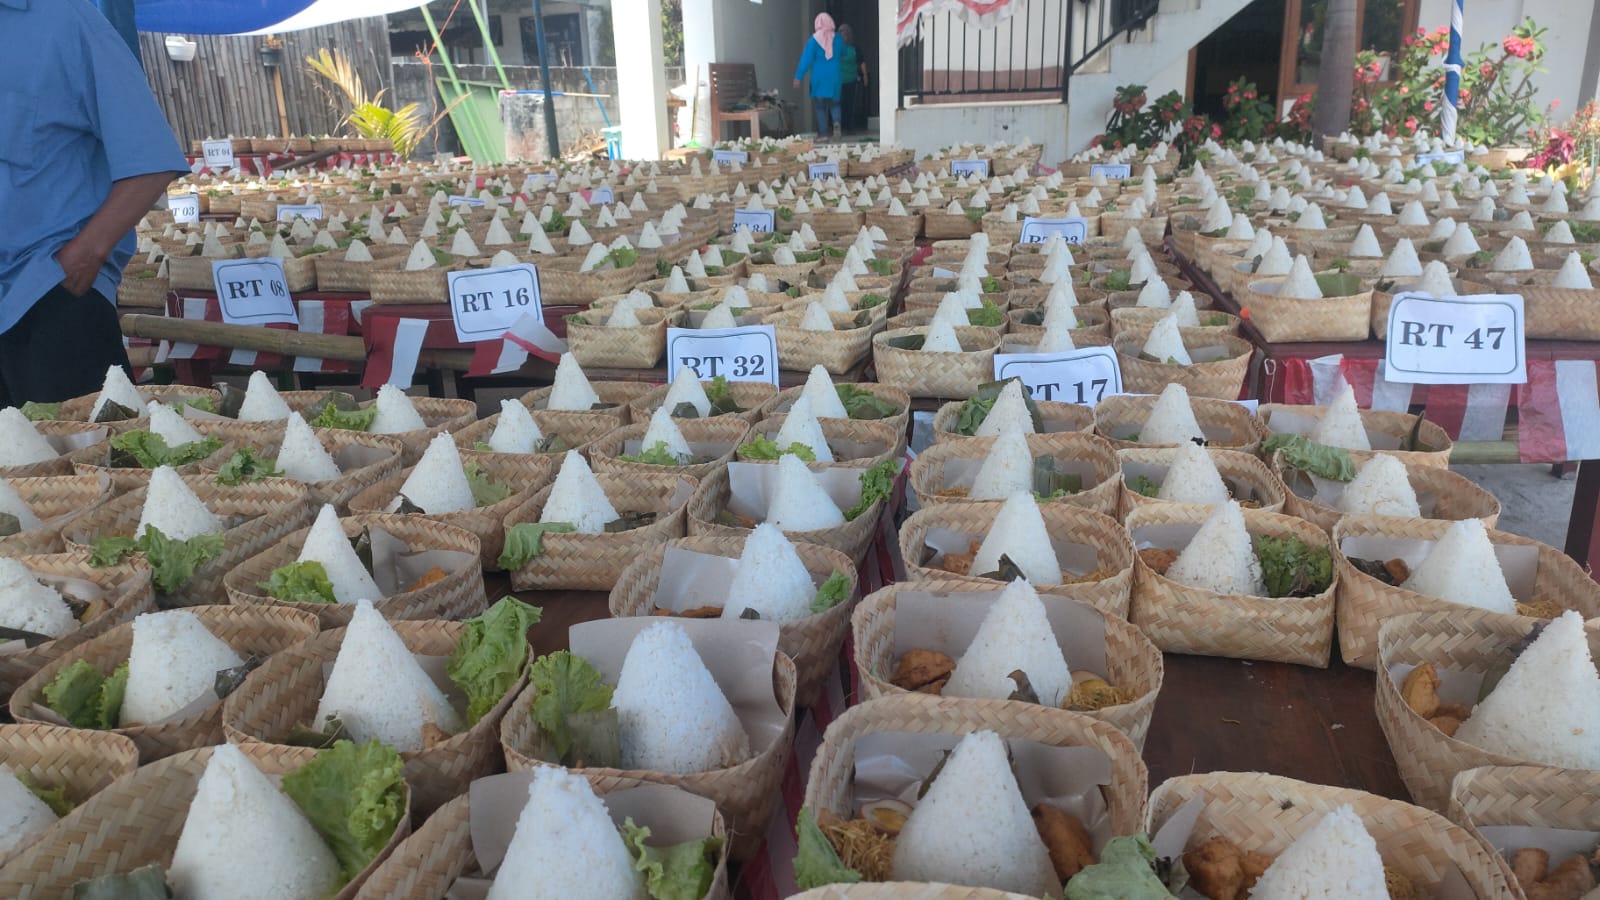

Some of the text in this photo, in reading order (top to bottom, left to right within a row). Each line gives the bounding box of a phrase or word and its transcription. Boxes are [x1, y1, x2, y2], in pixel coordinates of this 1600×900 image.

[182, 206, 195, 217] 03
[226, 279, 286, 299] RT 08
[461, 287, 530, 313] RT 16
[1399, 320, 1506, 350] RT 47
[680, 354, 765, 379] RT 32
[1073, 378, 1108, 404] 17
